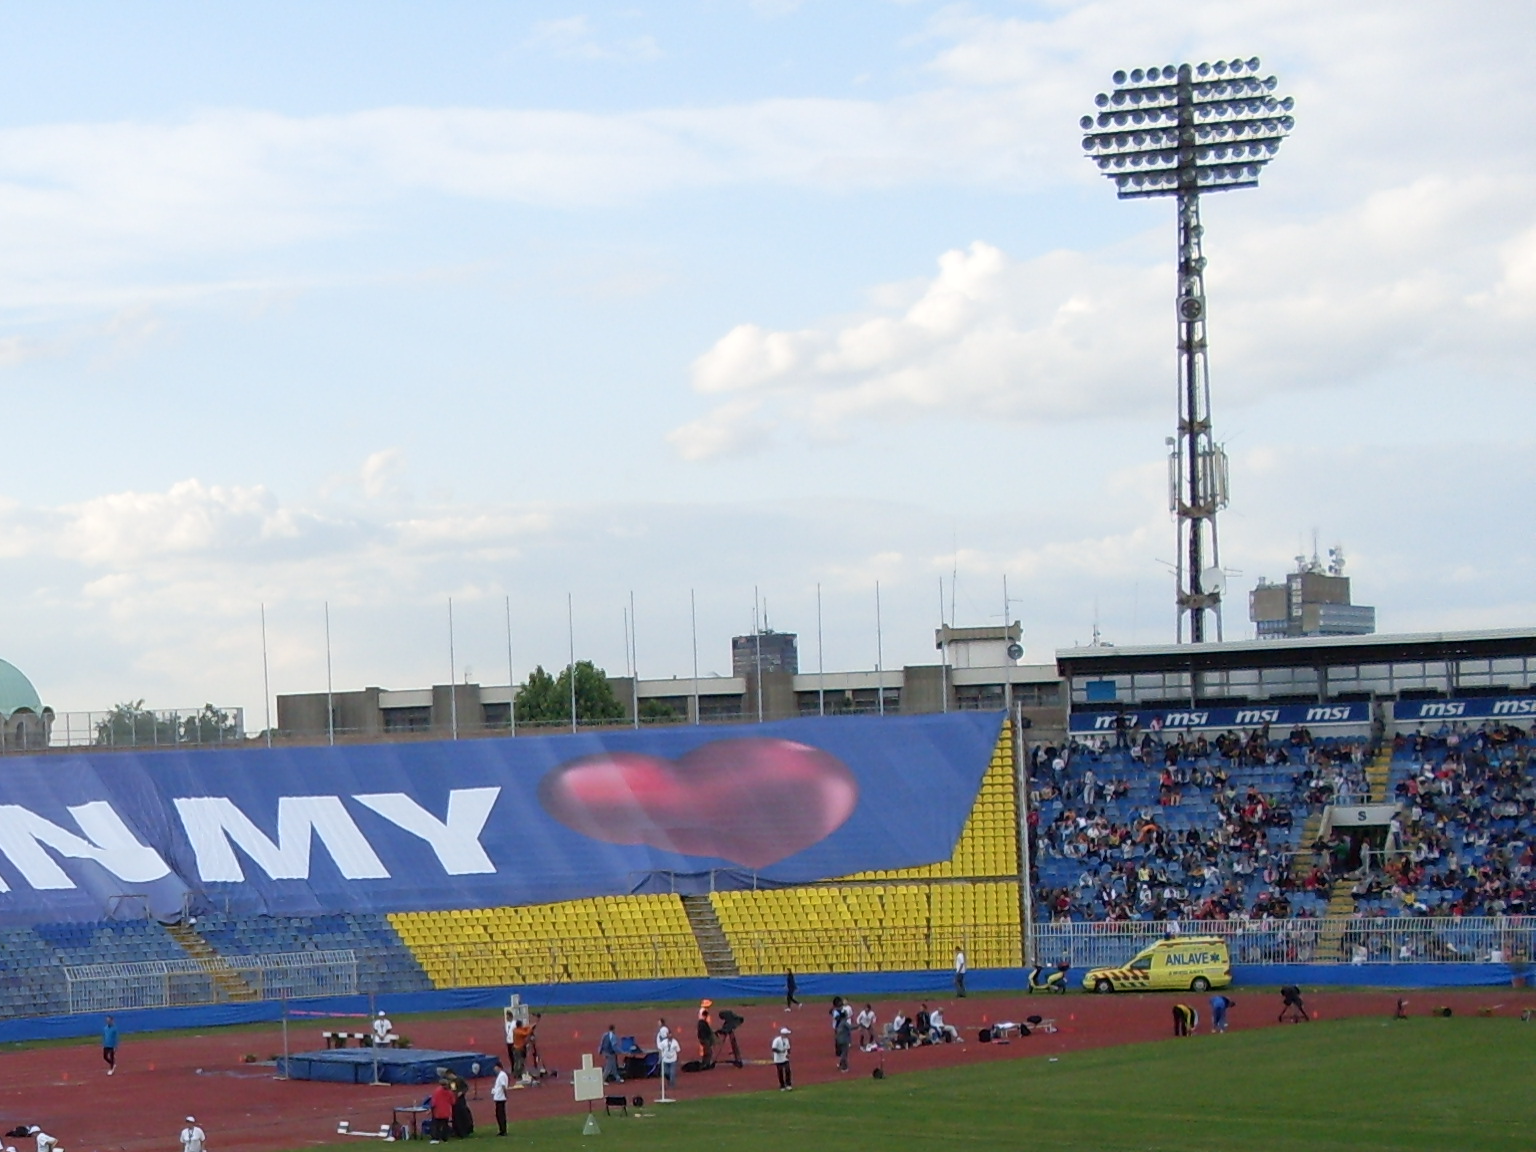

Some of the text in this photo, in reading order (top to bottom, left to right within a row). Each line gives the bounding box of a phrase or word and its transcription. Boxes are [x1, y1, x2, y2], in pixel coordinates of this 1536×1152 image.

[1235, 709, 1280, 724] msi
[1307, 706, 1352, 721] msi
[1419, 702, 1466, 717] msi
[1165, 711, 1209, 726] msi
[1357, 810, 1367, 821] S
[172, 787, 501, 883] MY
[1165, 952, 1210, 966] ANLAVE
